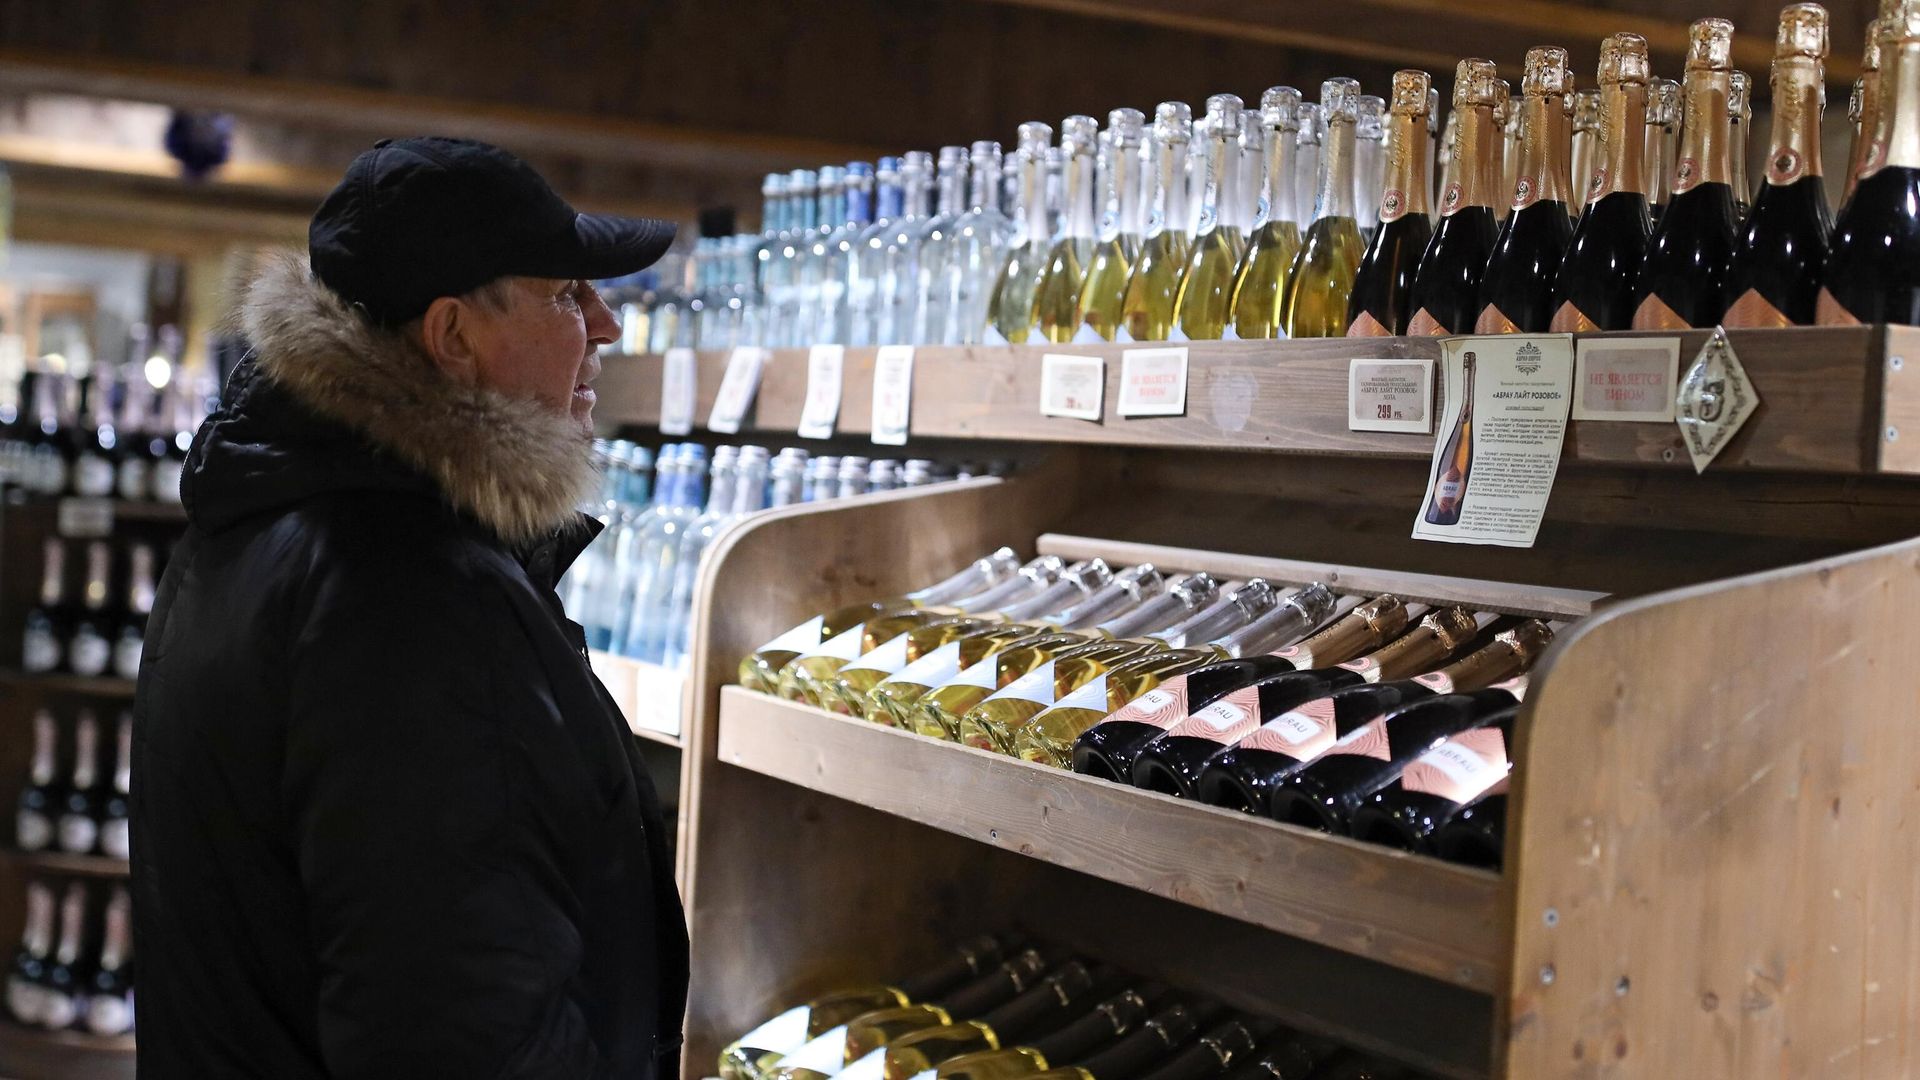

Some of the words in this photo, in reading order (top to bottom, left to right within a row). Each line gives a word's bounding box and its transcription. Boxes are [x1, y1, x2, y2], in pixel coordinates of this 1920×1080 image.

[1492, 391, 1514, 399] «АБРАУ
[1513, 389, 1530, 399] ЛАЙТ
[1531, 391, 1562, 400] РОЗОВОЕ»
[1377, 404, 1392, 419] 299
